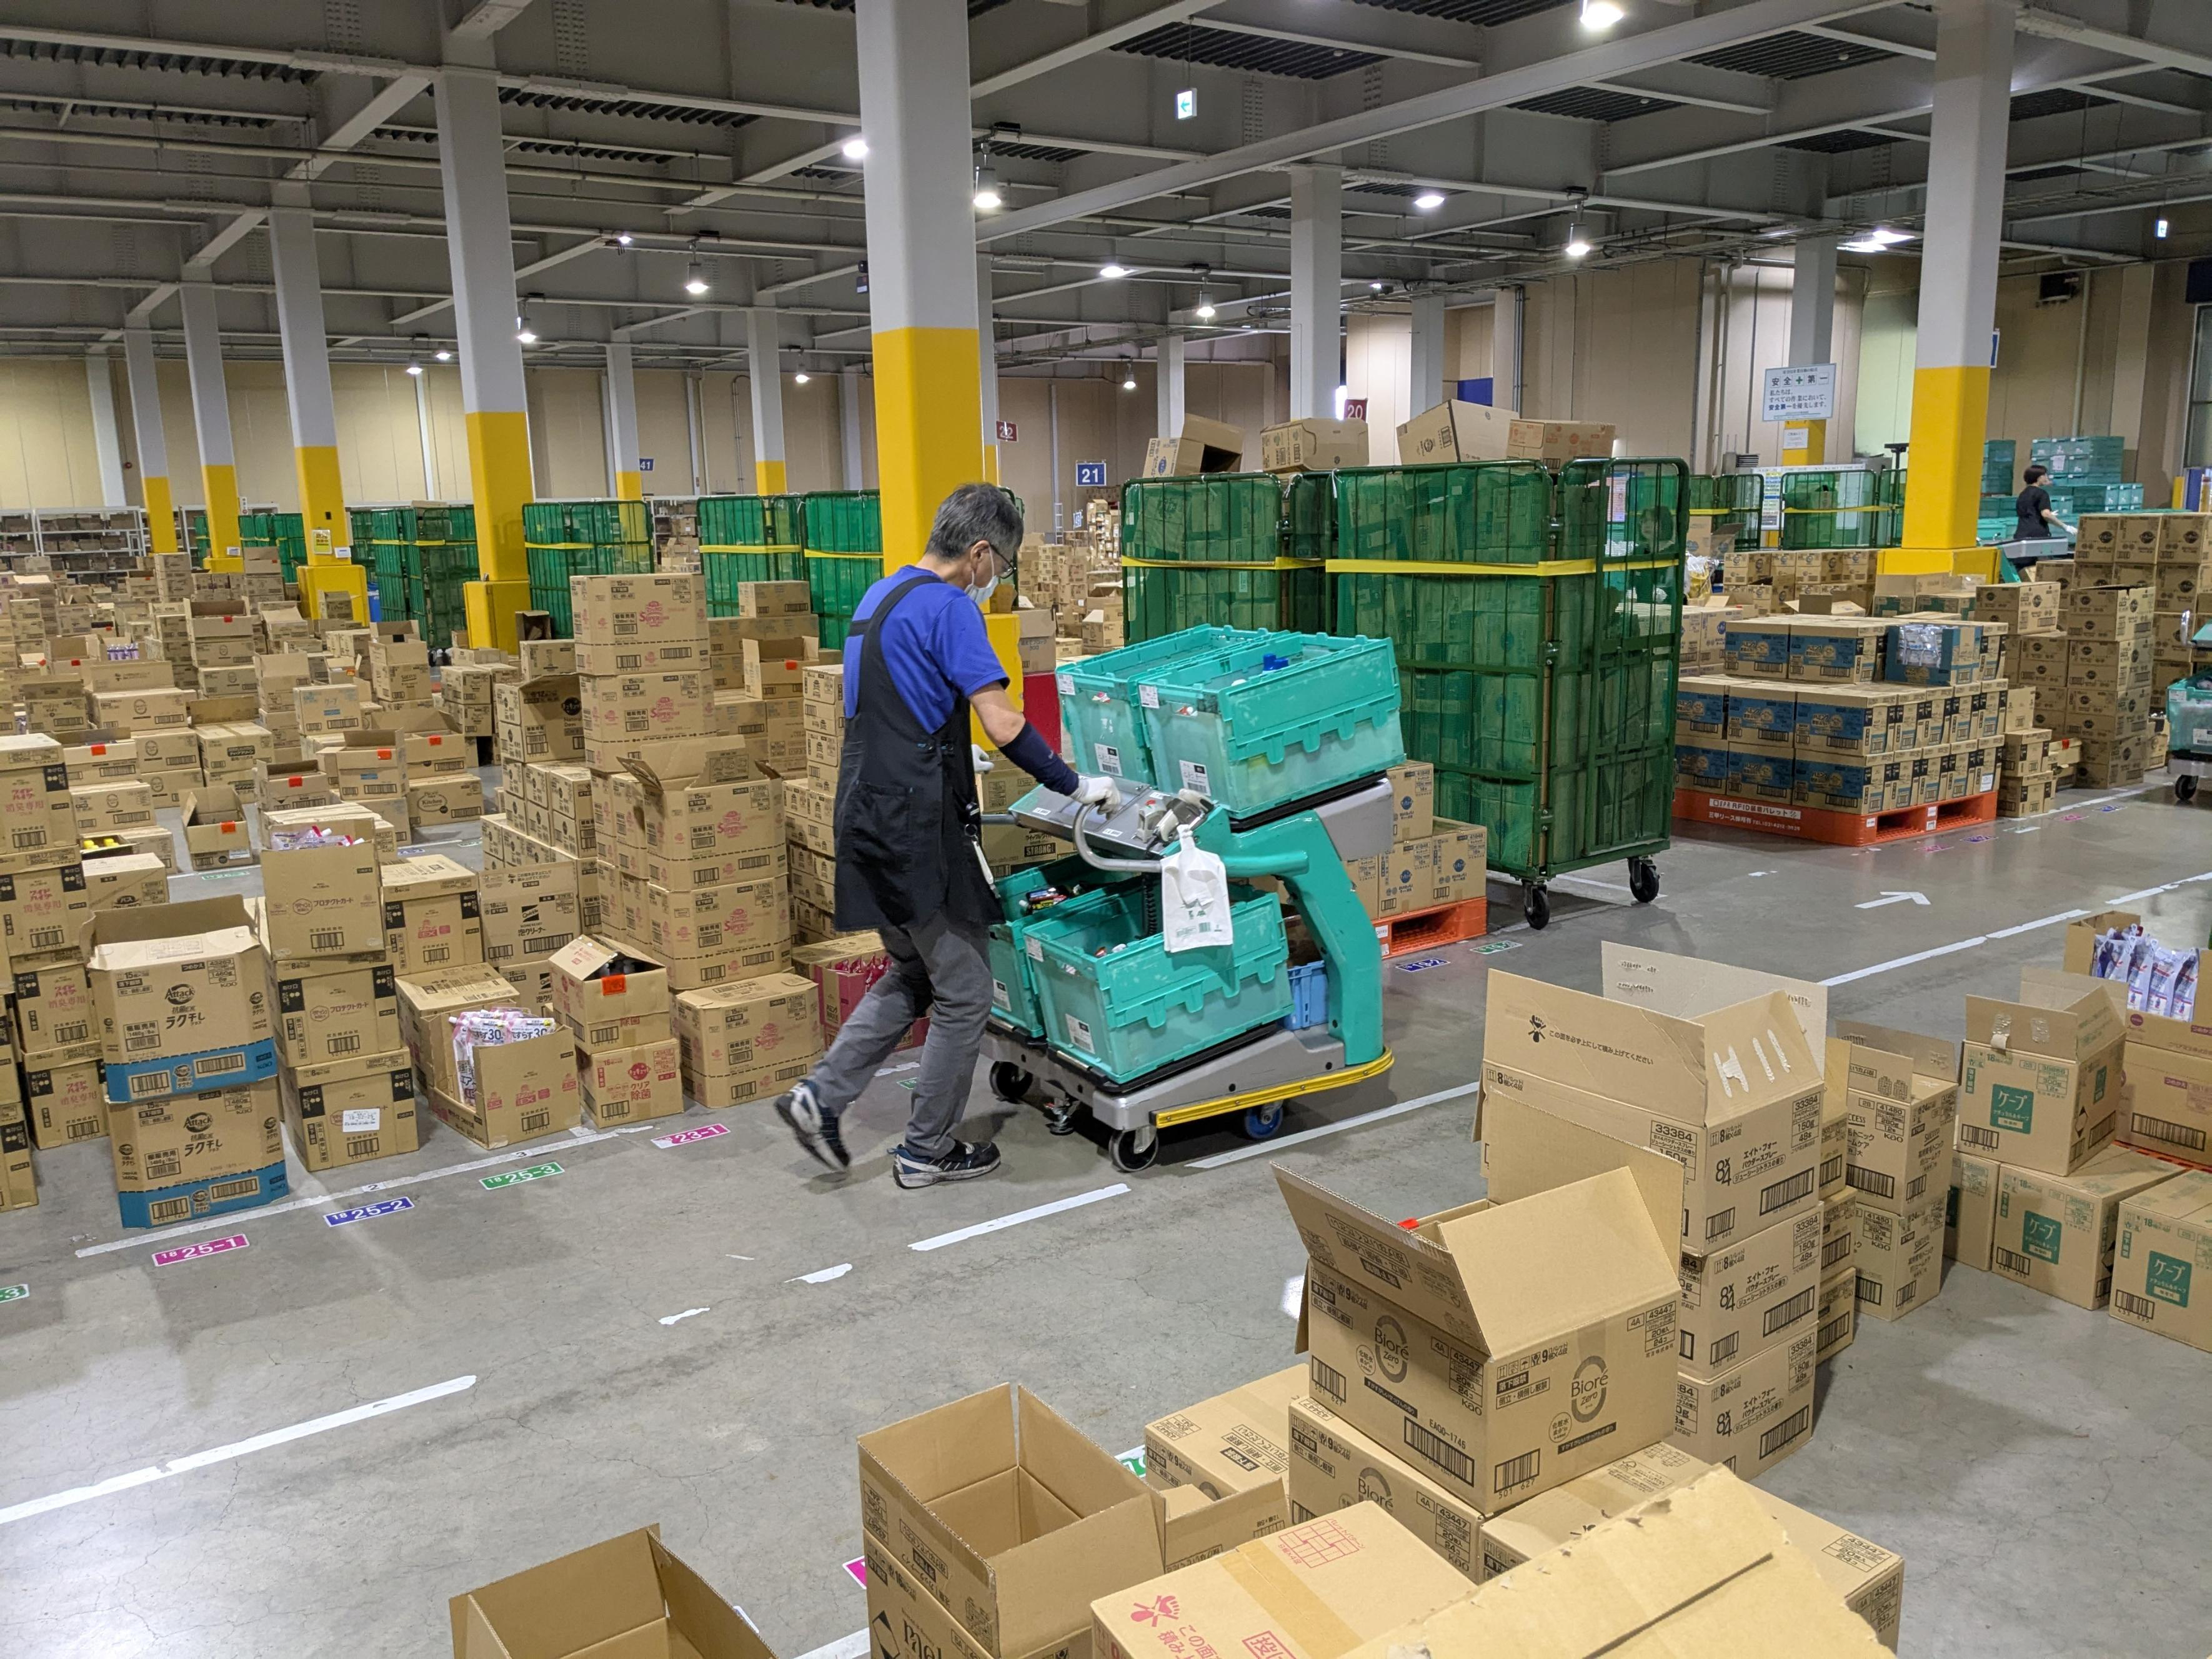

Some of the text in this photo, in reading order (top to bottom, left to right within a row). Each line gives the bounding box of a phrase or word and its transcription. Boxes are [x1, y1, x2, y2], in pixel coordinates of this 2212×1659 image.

[1772, 375, 1828, 386] 安全 第一
[1347, 403, 1363, 419] 20
[1082, 469, 1098, 483] 21
[517, 927, 546, 937] 泡クリーナー
[165, 987, 195, 1000] Attack
[166, 1012, 205, 1029] ラク干し
[620, 1016, 640, 1027] 除菌
[487, 1029, 502, 1041] 30
[1550, 1030, 1654, 1065] この面を必ず上にして積み上げてください
[630, 1082, 649, 1090] クリア
[1497, 1072, 1503, 1085] 8
[2166, 1078, 2186, 1089] つめかえ
[630, 1089, 651, 1100] 除菌
[1795, 1095, 1818, 1110] 33384
[1998, 1091, 2028, 1110] ケープ
[184, 1116, 213, 1128] Attack
[1798, 1119, 1815, 1132] 150g
[676, 1127, 720, 1143] 23-1
[1655, 1124, 1693, 1142] 33384
[1720, 1129, 1725, 1143] 8
[1798, 1131, 1812, 1142] 48本
[1884, 1133, 1903, 1143] Kao
[185, 1140, 222, 1157] ラク干し
[1743, 1141, 1777, 1159] エイト・フォー
[1742, 1150, 1777, 1169] パウダースプレー
[506, 1165, 555, 1183] 25-3
[1735, 1155, 1784, 1182] ジューシーシトラスの香り
[332, 1200, 406, 1220] 18 25-2
[1796, 1215, 1818, 1233] 33384
[2030, 1219, 2056, 1240] ケープ
[161, 1238, 237, 1259] 18 25-1
[1799, 1239, 1815, 1252] 150g
[1871, 1241, 1890, 1251] Kao
[1724, 1257, 1728, 1270] 8
[1800, 1251, 1813, 1262] 48本
[1747, 1265, 1779, 1283] エイト・フォー
[2155, 1260, 2185, 1281] ケープ
[1746, 1273, 1780, 1293] パウダースプレー
[1345, 1286, 1351, 1300] 9
[1738, 1277, 1786, 1307] ジューシーシトラスの香り
[1648, 1304, 1673, 1318] 43447
[1631, 1317, 1641, 1326] 4A
[1375, 1327, 1409, 1360] Bioré
[1435, 1342, 1445, 1353] 4A
[1791, 1337, 1812, 1355] 33384
[1383, 1351, 1400, 1364] Zero
[1453, 1352, 1480, 1372] 43447
[1542, 1350, 1548, 1362] 9
[1794, 1360, 1810, 1374] 150g
[1499, 1373, 1527, 1392] 落下厳禁
[1571, 1368, 1608, 1397] Bioré
[1720, 1384, 1725, 1397] 8
[1314, 1383, 1343, 1407] 501 627
[1499, 1381, 1548, 1406] 倒立・横倒し厳禁
[1580, 1391, 1598, 1406] Zero
[1743, 1387, 1776, 1409] エイト・フォー
[1303, 1401, 1330, 1418] 43447
[1462, 1398, 1482, 1416] Kao
[1742, 1396, 1776, 1418] パウダースプレー
[1552, 1418, 1569, 1430] 化粧水
[1735, 1400, 1781, 1432] ジューシーシトラスの香り
[1157, 1425, 1176, 1440] 43447
[1328, 1438, 1333, 1450] 9
[1173, 1456, 1179, 1466] 9
[1223, 1447, 1257, 1470] 落下厳禁
[1227, 1435, 1282, 1472] 倒立・横倒し厳禁
[1358, 1477, 1393, 1511] Bioré
[1498, 1478, 1535, 1499] 501 627
[1421, 1497, 1431, 1508] 4A
[1439, 1508, 1468, 1528] 43447
[1328, 1518, 1366, 1549] パレットパターン
[1443, 1530, 1463, 1547] 20枚入
[1443, 1542, 1460, 1555] 24コ
[1848, 1538, 1886, 1556] 43447
[1448, 1554, 1469, 1572] Kao
[1875, 1577, 1897, 1596] 43447
[1157, 1630, 1199, 1659] 積み
[1180, 1624, 1222, 1659] この面
